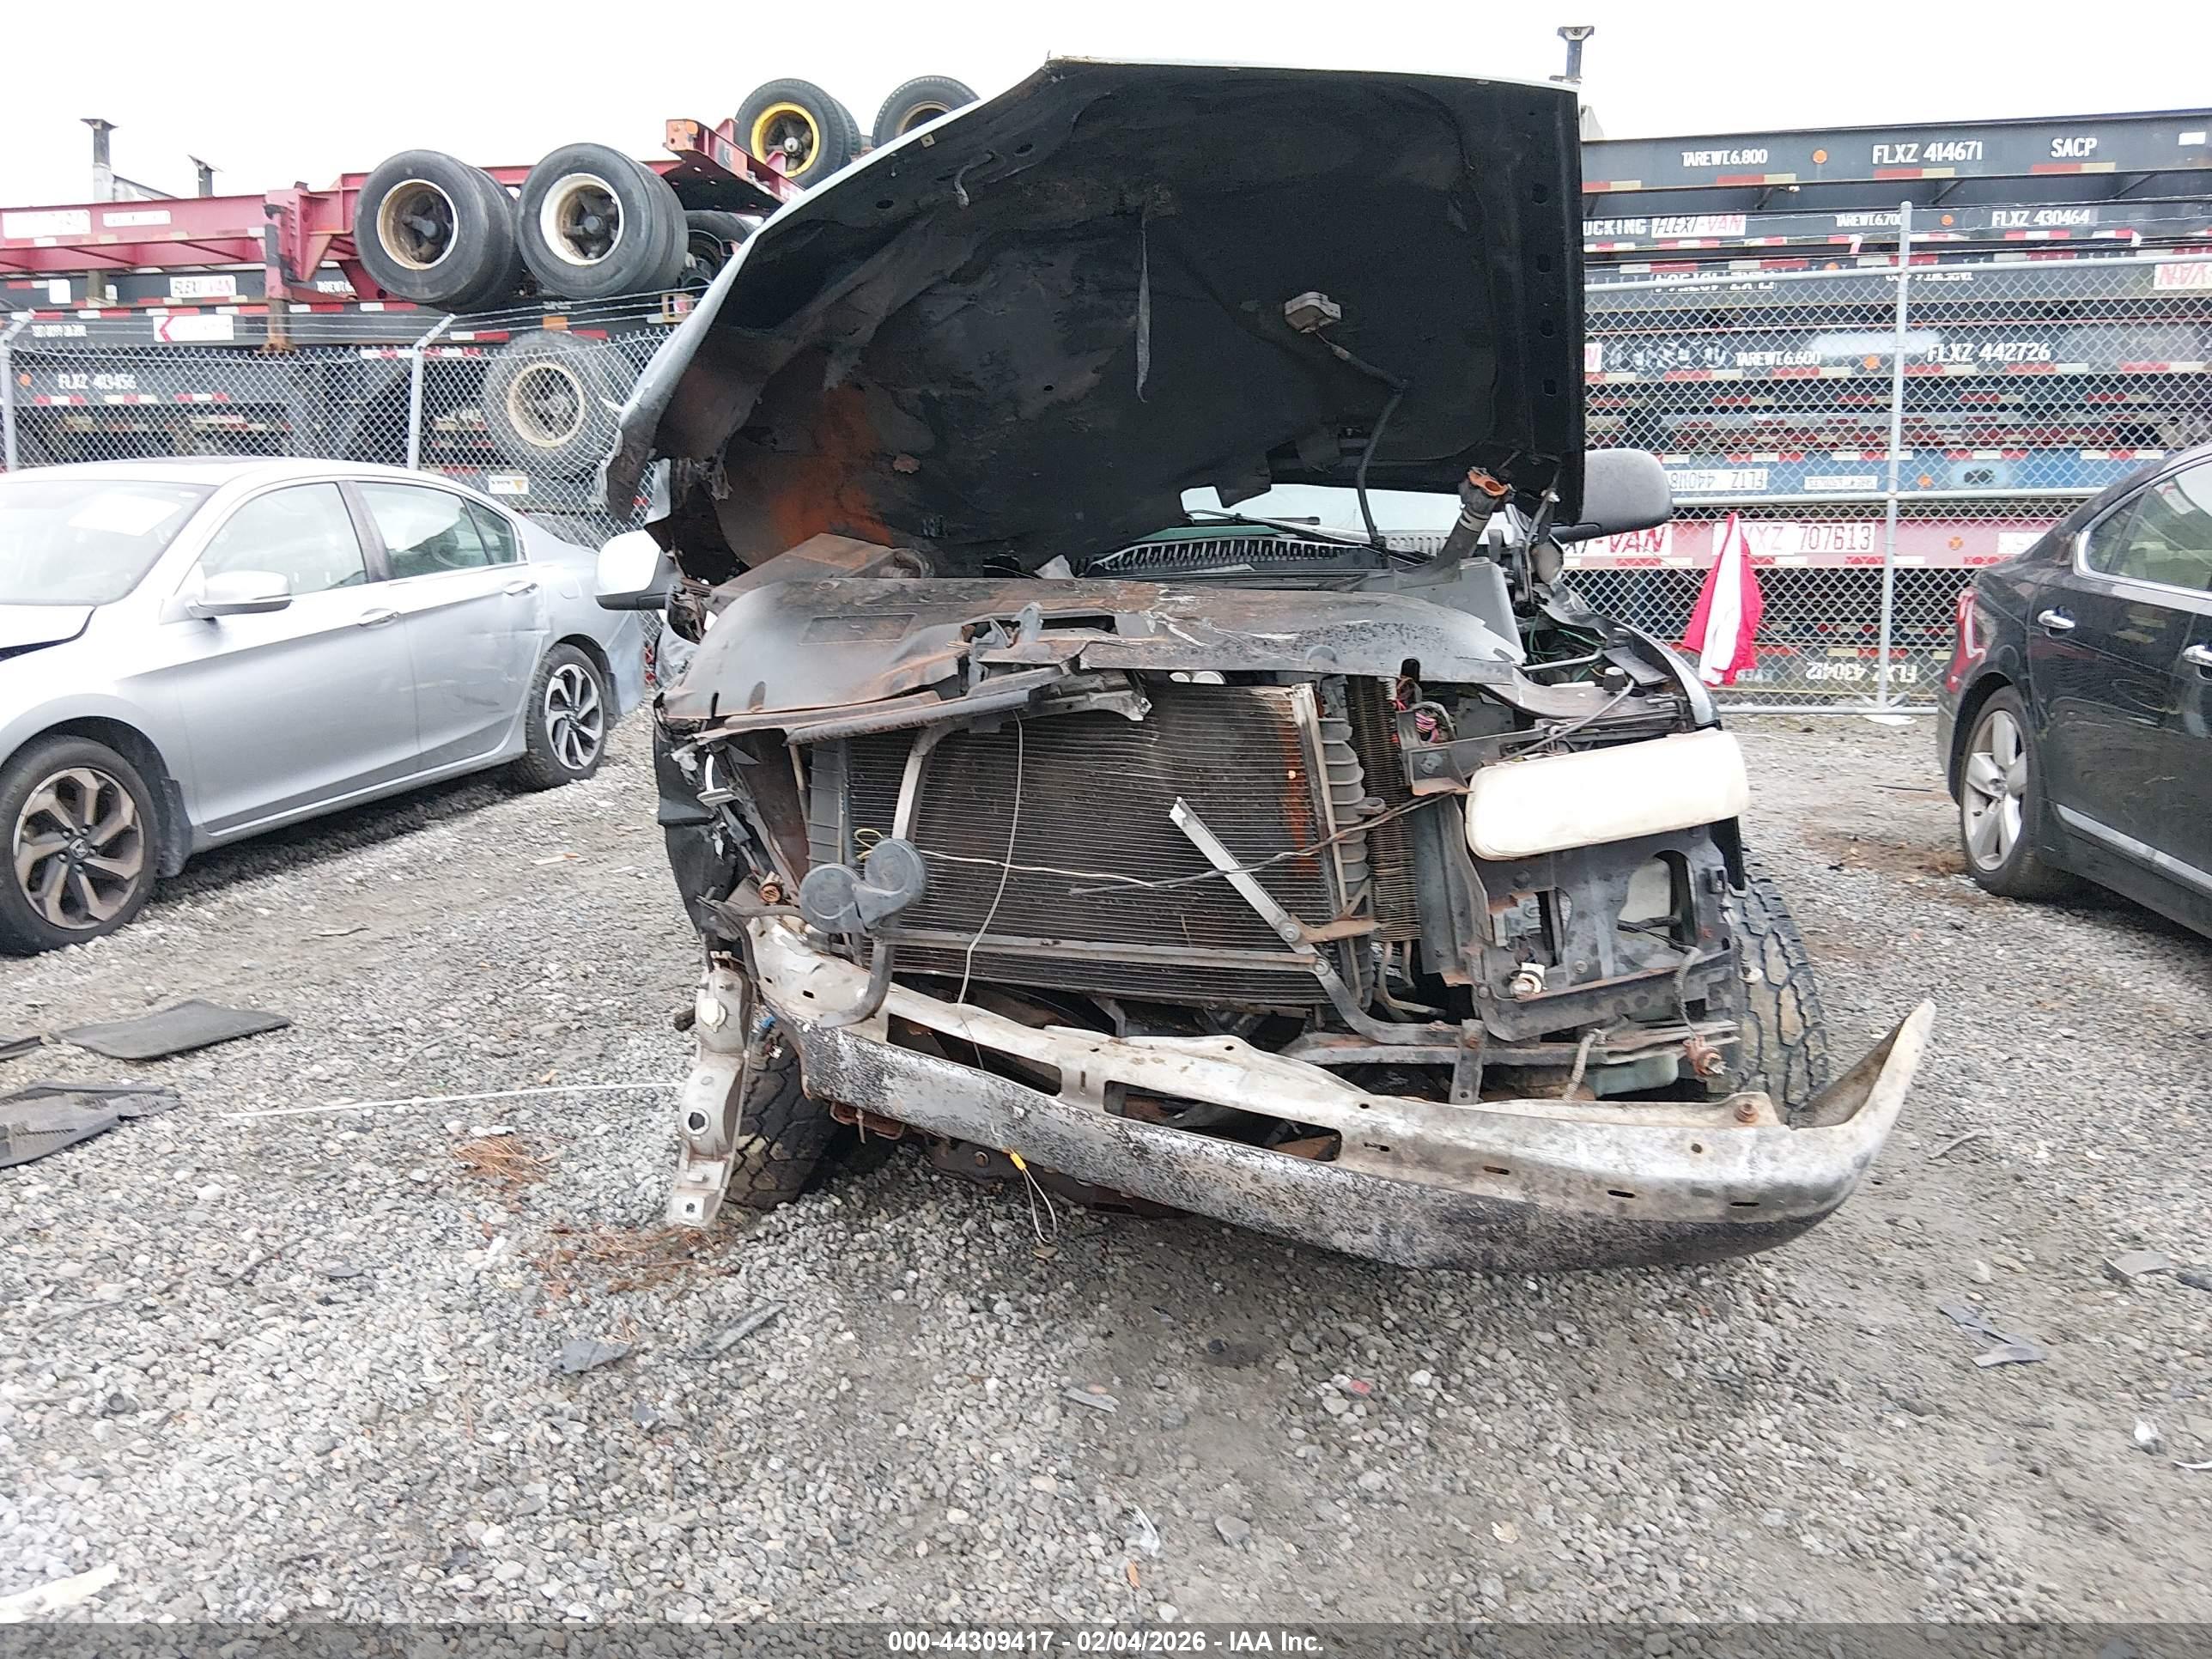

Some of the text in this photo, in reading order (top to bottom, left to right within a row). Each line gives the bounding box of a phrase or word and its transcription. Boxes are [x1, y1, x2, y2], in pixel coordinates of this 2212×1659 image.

[1872, 141, 1983, 164] FLXZ 414671
[2051, 137, 2098, 157] SACP
[1991, 209, 2090, 227] FLXZ 430464
[1927, 343, 2051, 362] FLXZ 442726
[1800, 522, 1870, 550] 707613
